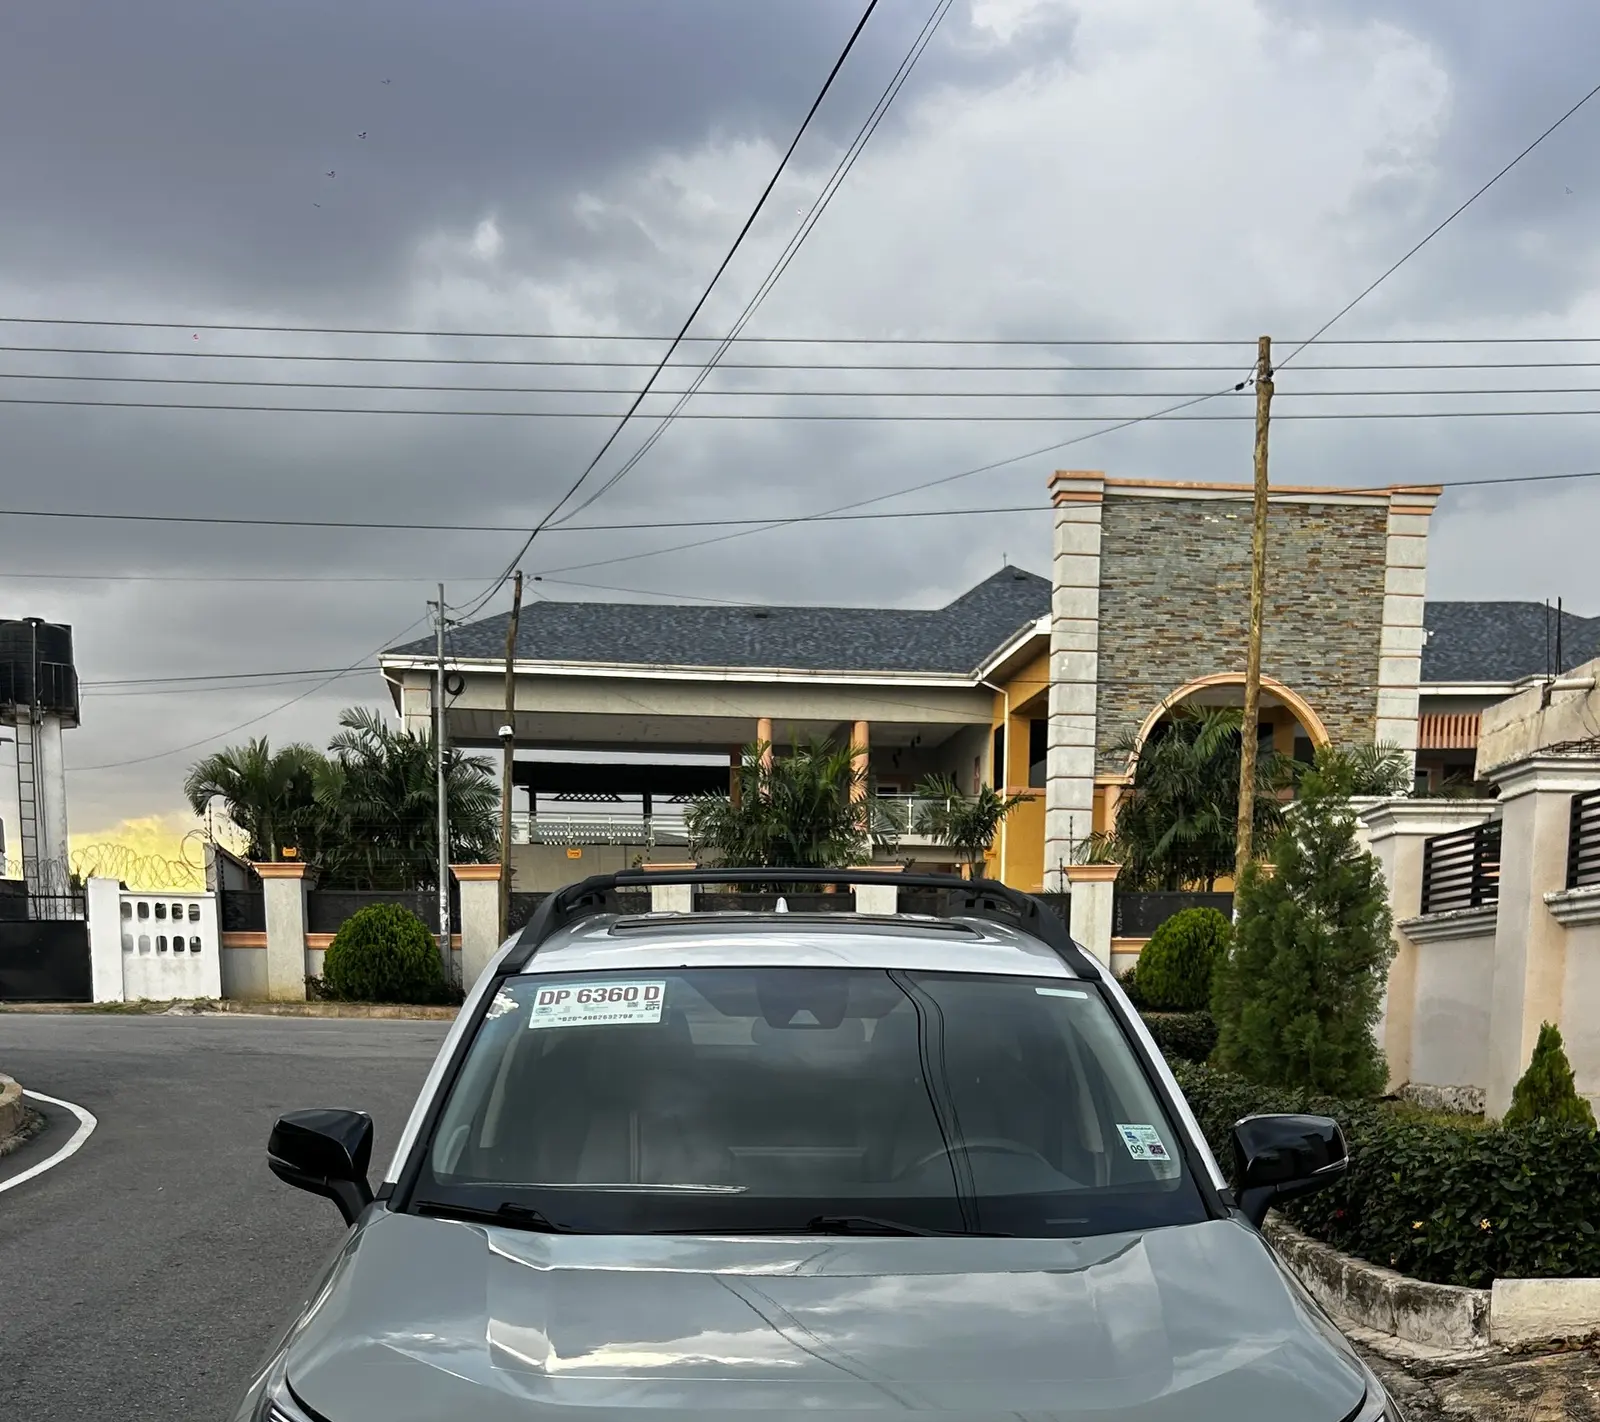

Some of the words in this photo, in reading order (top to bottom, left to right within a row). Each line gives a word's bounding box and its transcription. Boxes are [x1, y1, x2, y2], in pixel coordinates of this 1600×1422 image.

[538, 990, 571, 1006] DP
[576, 986, 639, 1004] 6360
[644, 986, 660, 1001] D
[1130, 1144, 1144, 1154] 09
[1149, 1144, 1164, 1154] 25
